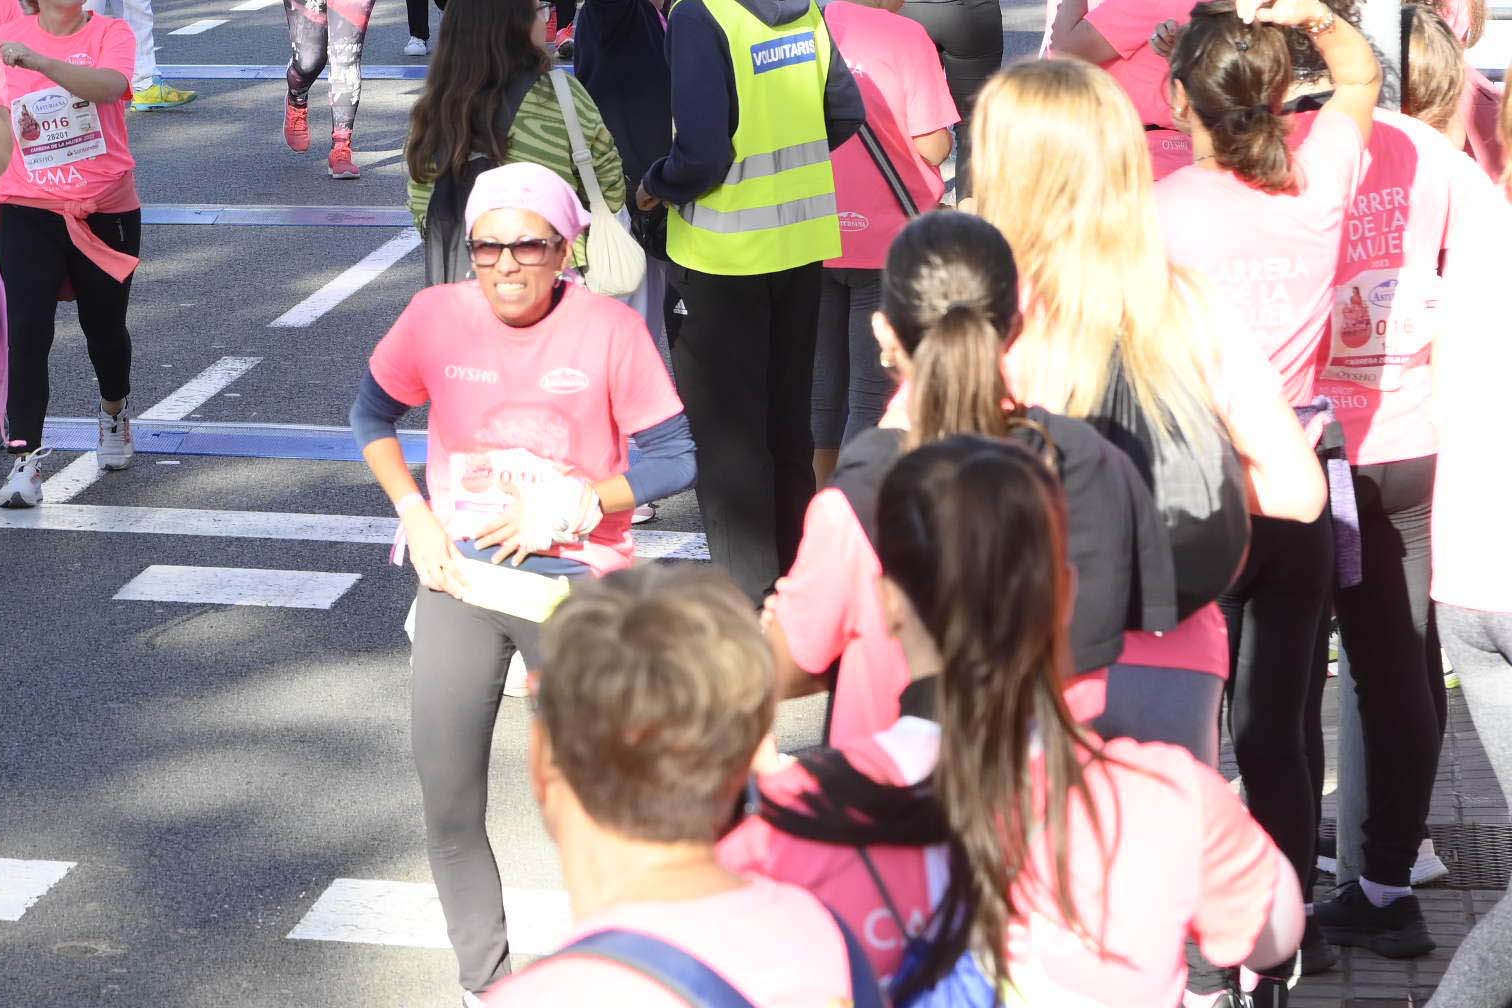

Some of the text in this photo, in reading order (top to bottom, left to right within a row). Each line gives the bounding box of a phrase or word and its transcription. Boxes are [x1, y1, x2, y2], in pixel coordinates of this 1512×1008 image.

[752, 39, 816, 67] VOLUNTARIS
[41, 116, 69, 131] 016
[1349, 217, 1375, 242] DE
[1346, 232, 1402, 263] MUJE
